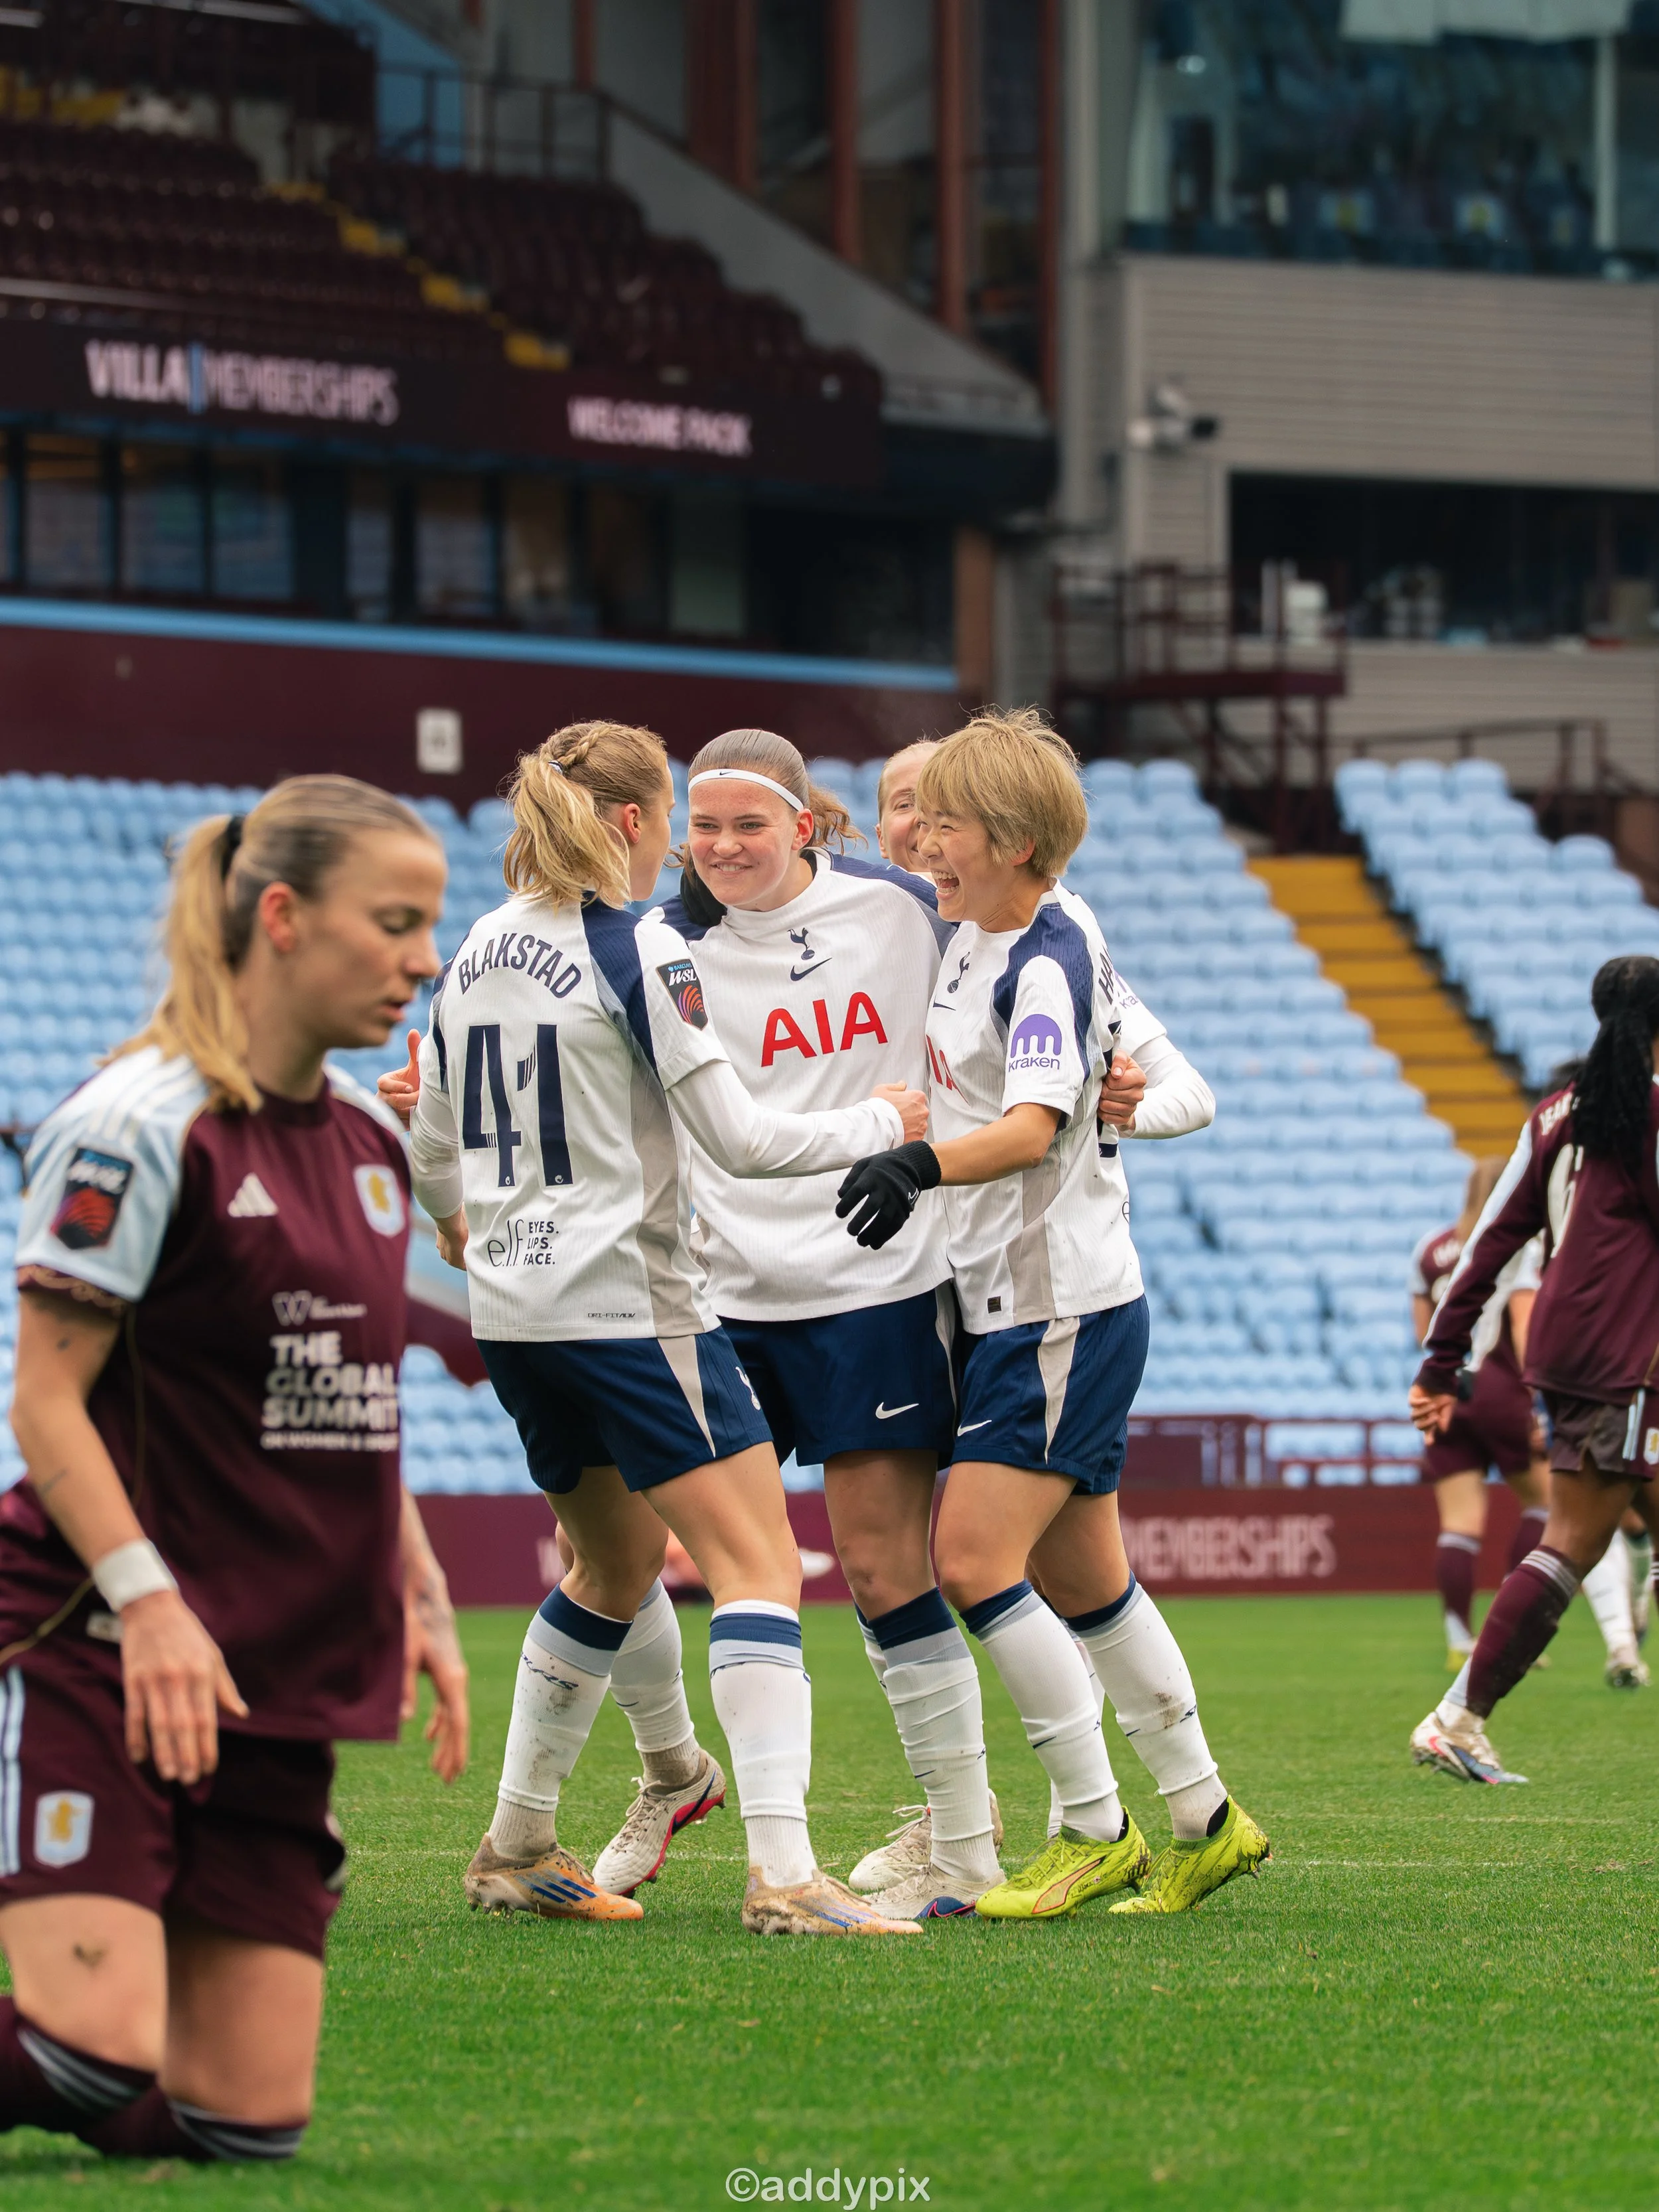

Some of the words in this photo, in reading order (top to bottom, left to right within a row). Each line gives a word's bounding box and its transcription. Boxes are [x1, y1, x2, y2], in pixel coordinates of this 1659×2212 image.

[86, 339, 188, 404] VILLA
[459, 933, 581, 998] BLAKSTAD
[668, 968, 697, 986] WSL
[1098, 944, 1114, 1005] HA
[761, 992, 888, 1067] AIA
[926, 1034, 972, 1107] IA
[1008, 1057, 1060, 1072] kraken
[463, 1024, 573, 1187] 41
[527, 1237, 552, 1249] LIPS.
[528, 1221, 559, 1234] EYES.
[524, 1253, 555, 1265] FACE.
[269, 1330, 342, 1367] THE
[267, 1362, 397, 1398] GLOBAL
[261, 1396, 398, 1430] SUMMIT
